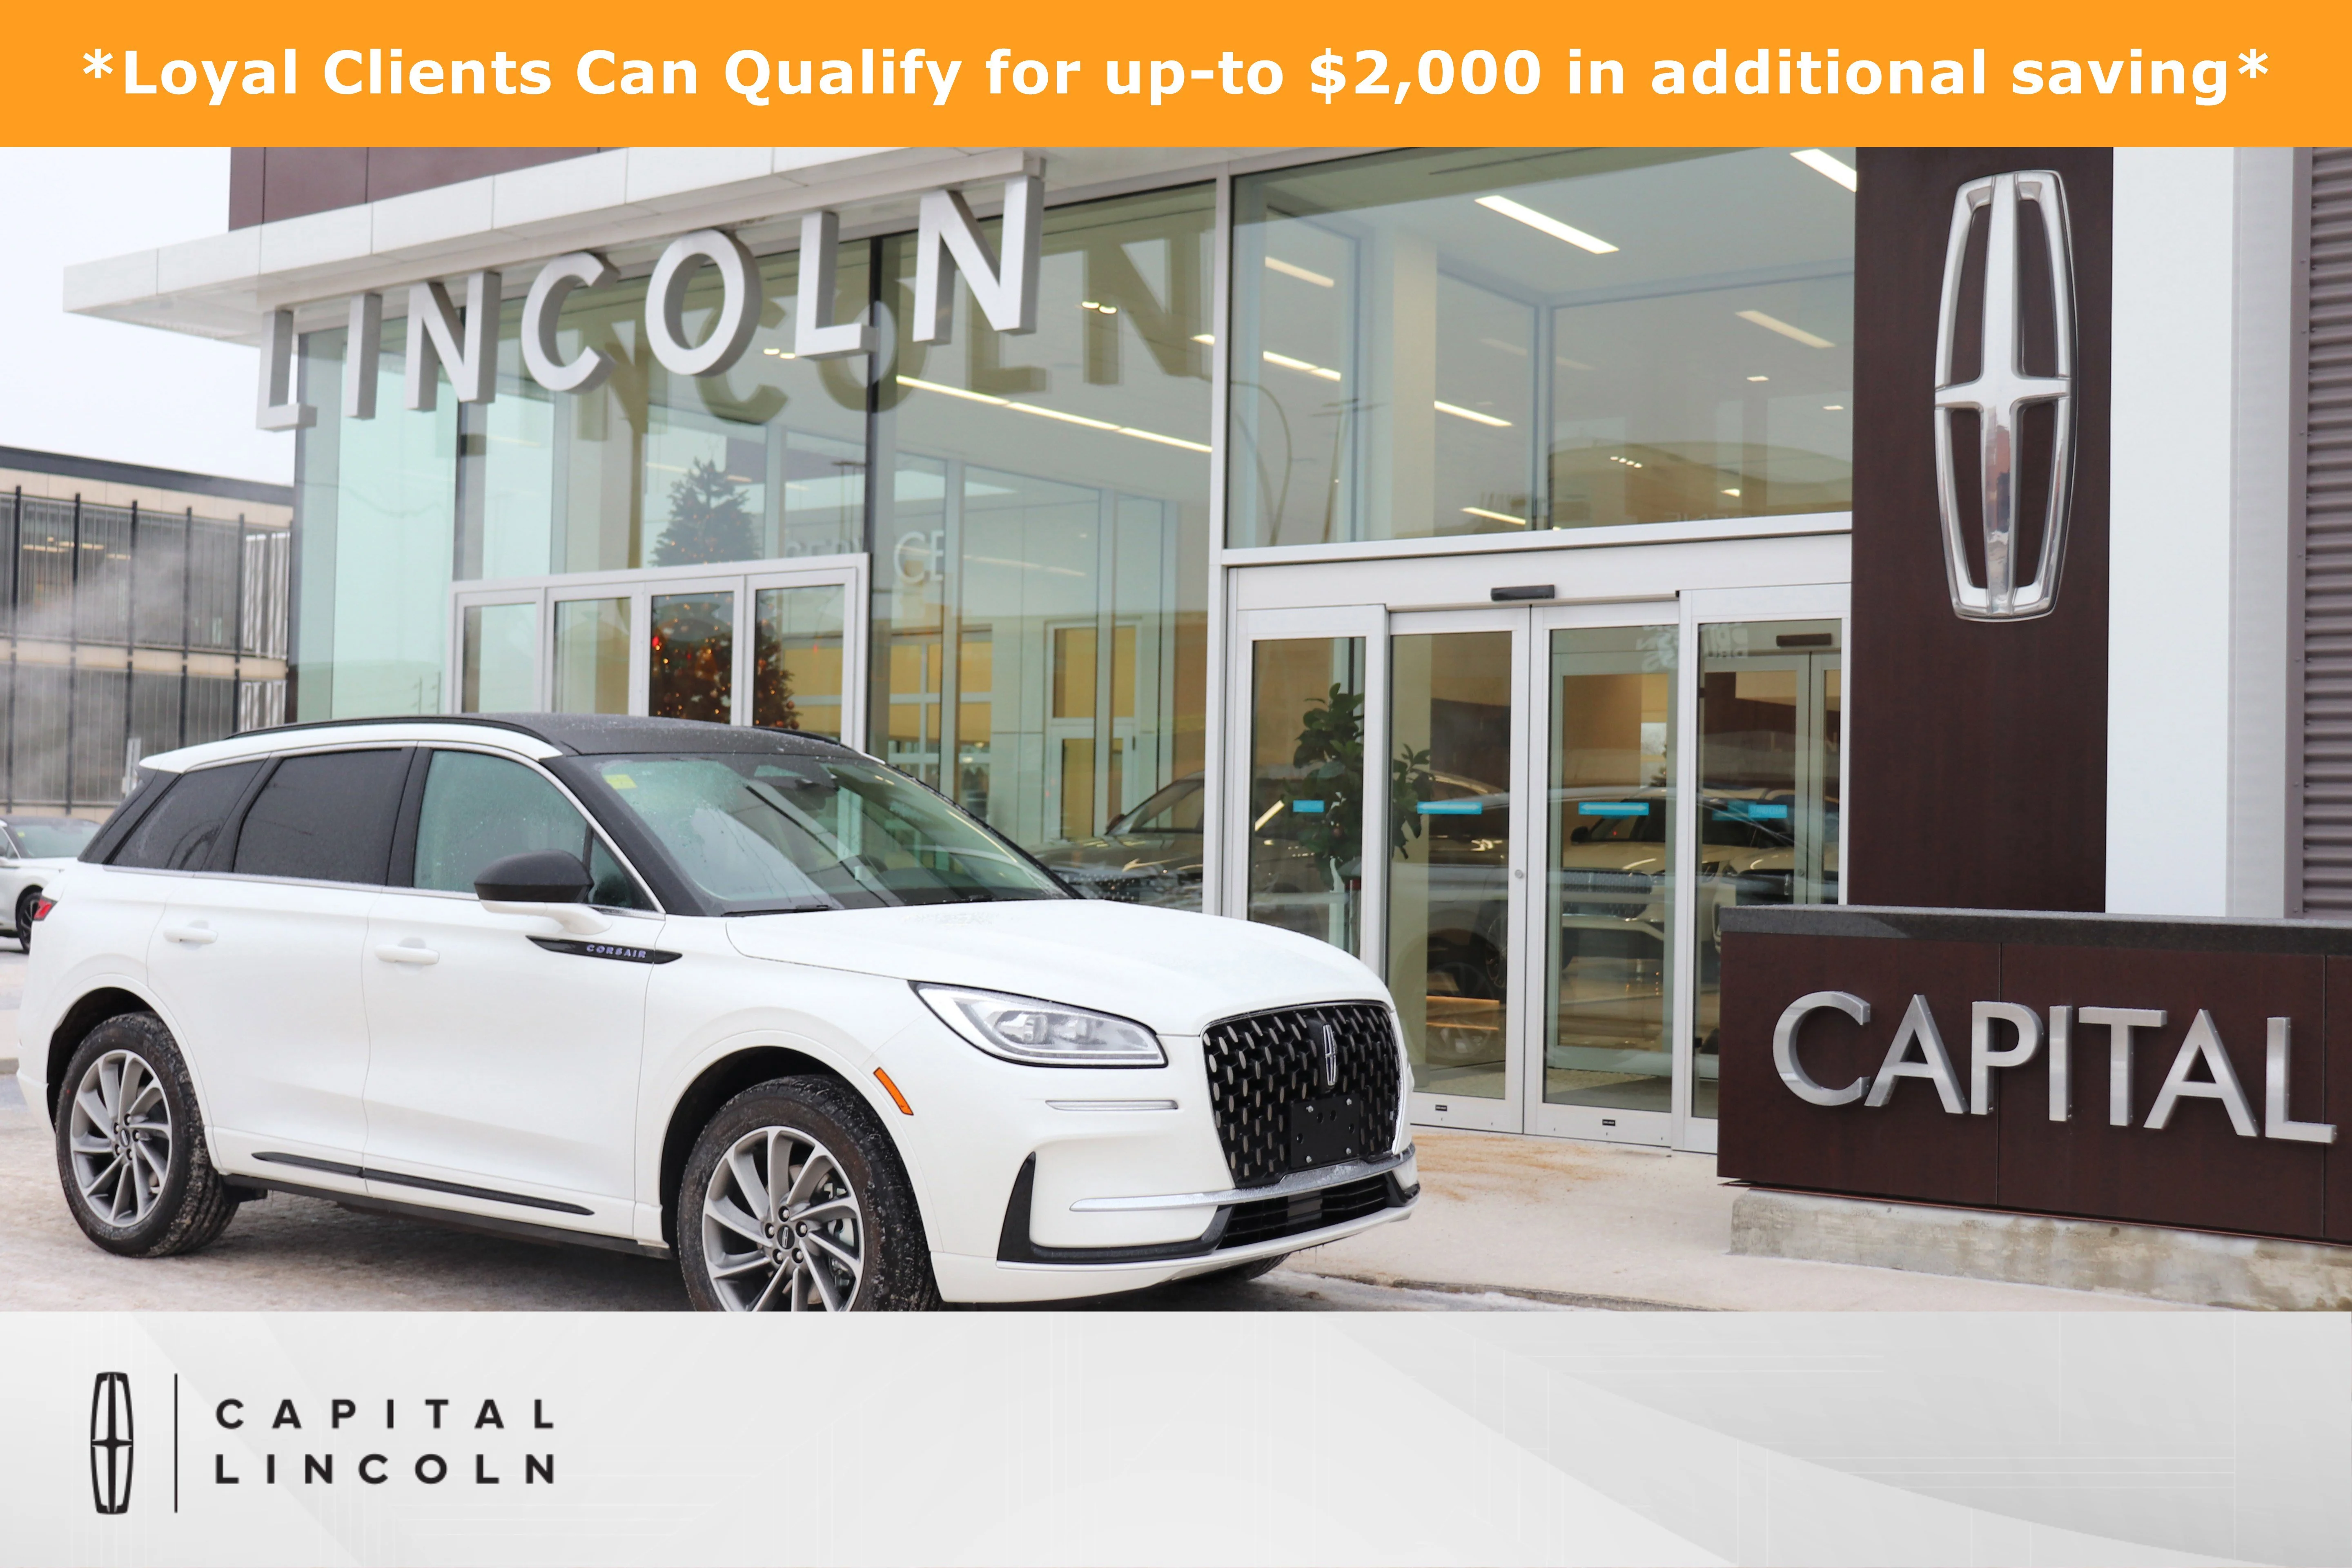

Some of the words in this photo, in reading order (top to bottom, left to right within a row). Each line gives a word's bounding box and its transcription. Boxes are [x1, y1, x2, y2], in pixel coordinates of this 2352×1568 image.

[256, 174, 1045, 433] LINCOLN
[586, 944, 647, 959] CORSAIR
[1772, 990, 2337, 1144] CAPITAL
